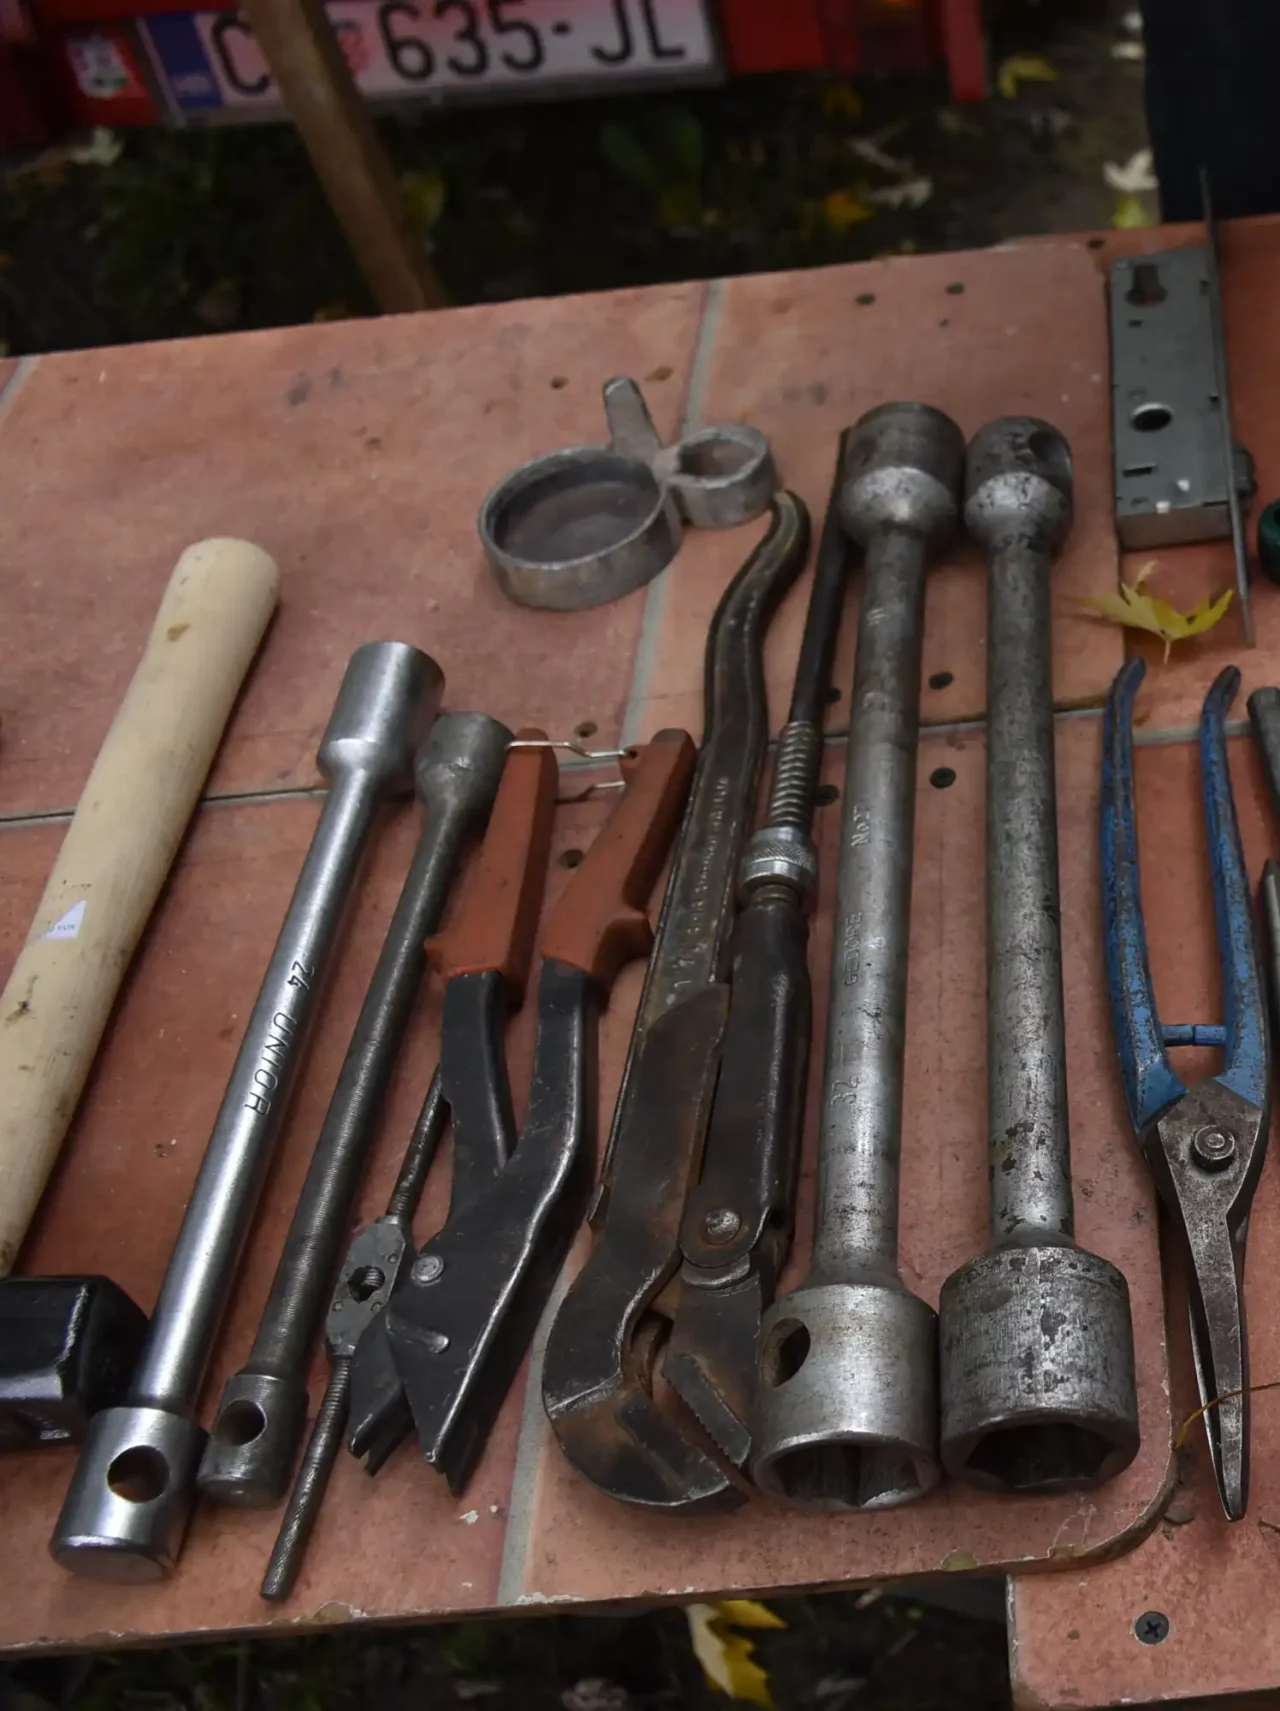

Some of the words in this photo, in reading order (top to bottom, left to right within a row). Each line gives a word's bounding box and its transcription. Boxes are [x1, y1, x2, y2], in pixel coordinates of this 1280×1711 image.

[287, 960, 316, 991] 24
[843, 910, 863, 986] GEDORE
[244, 1011, 299, 1117] UNIOR
